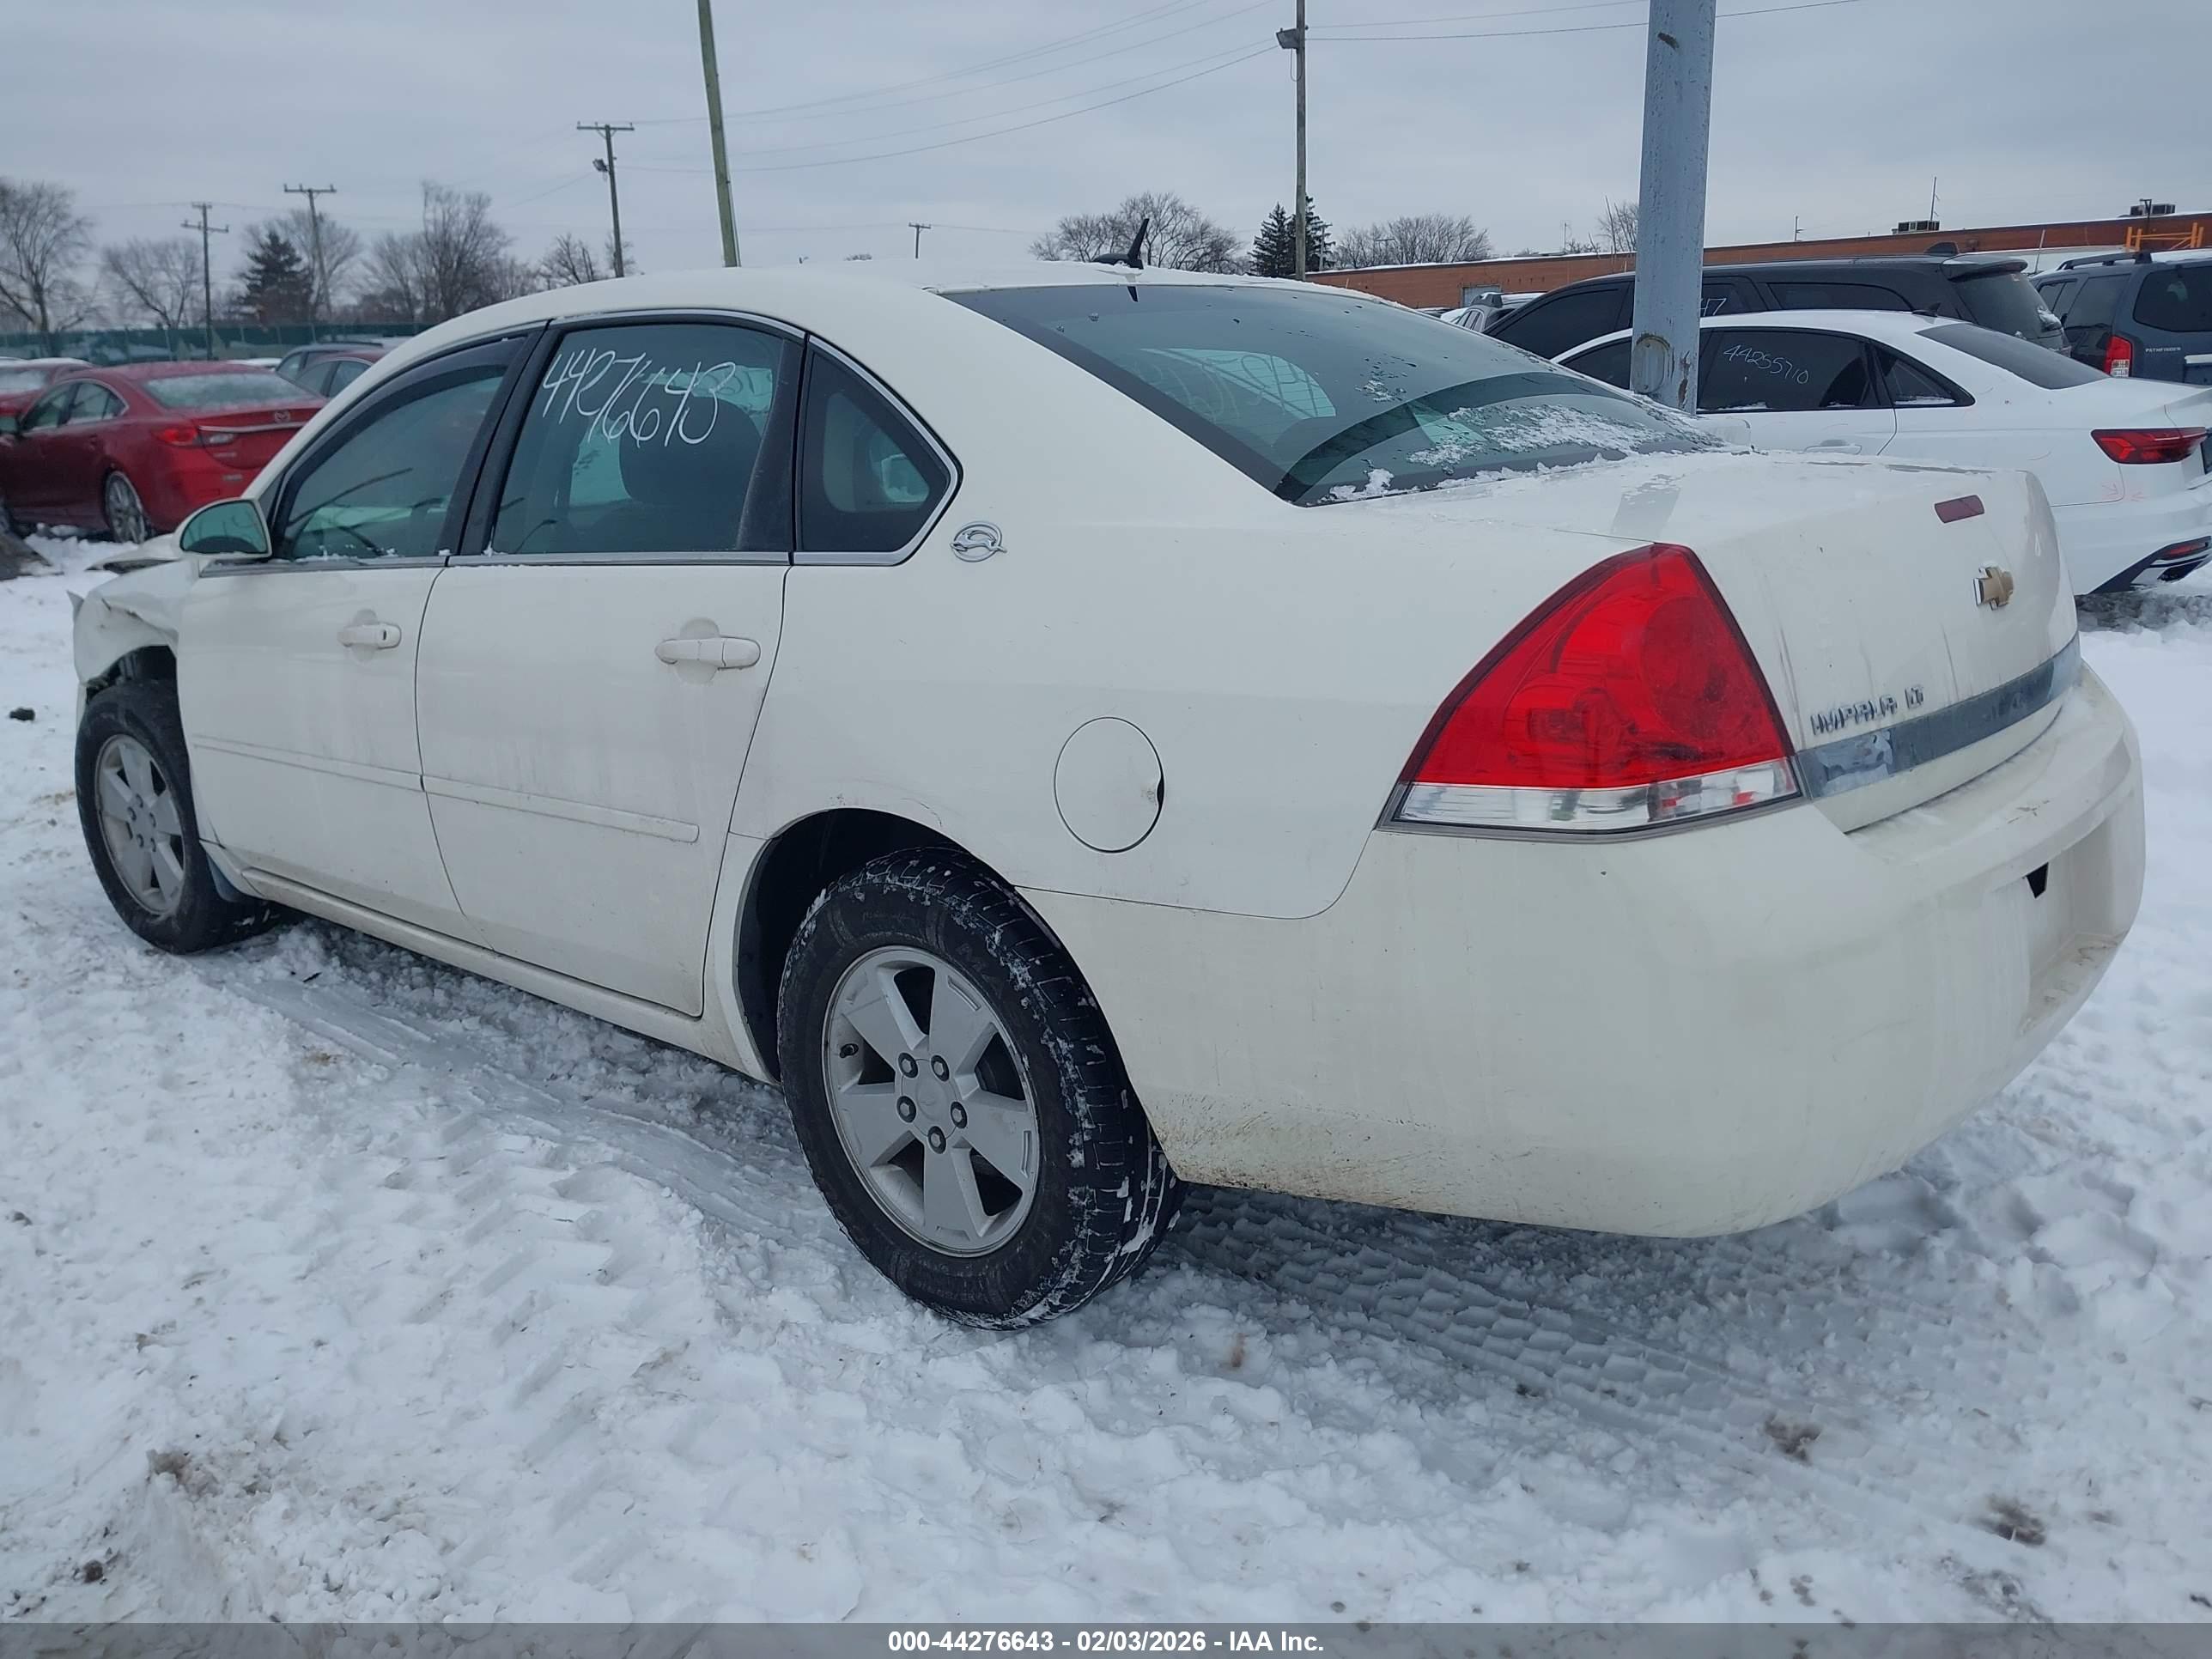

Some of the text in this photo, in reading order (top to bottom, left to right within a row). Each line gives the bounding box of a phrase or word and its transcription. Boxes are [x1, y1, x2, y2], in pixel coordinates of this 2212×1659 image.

[1723, 345, 1809, 384] 44255710
[542, 348, 736, 448] 44276643
[1810, 685, 1924, 735] IMPALA LT
